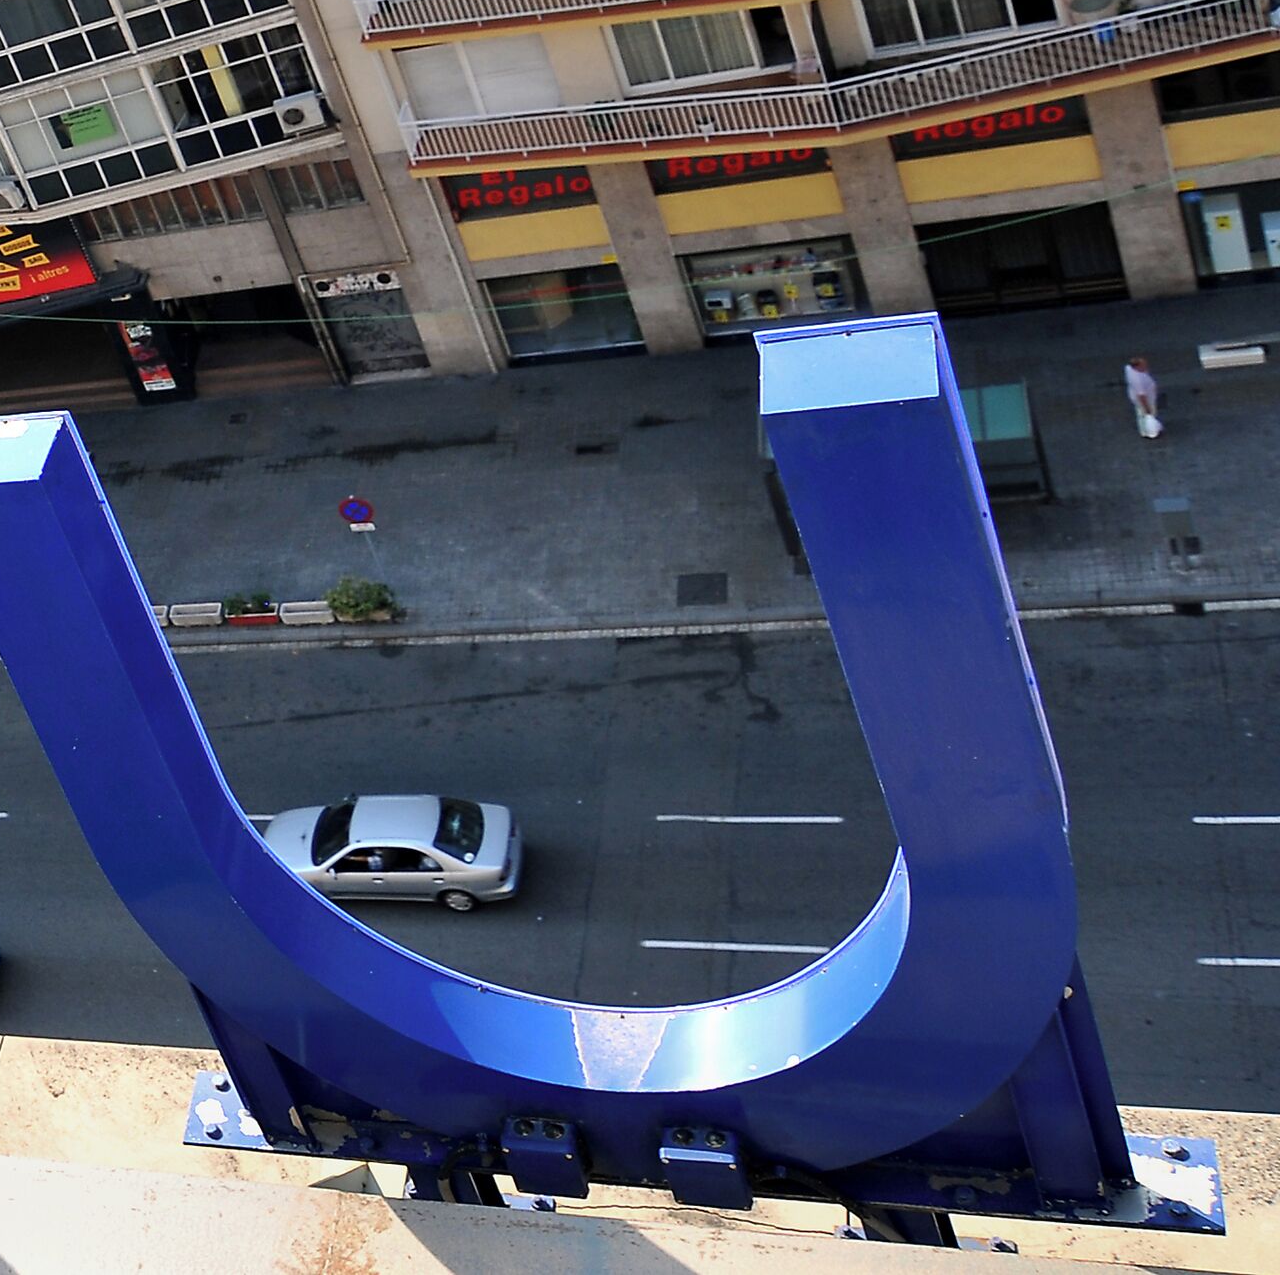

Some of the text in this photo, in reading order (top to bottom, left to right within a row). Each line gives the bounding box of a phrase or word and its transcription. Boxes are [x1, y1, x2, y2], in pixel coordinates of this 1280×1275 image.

[915, 103, 1066, 143] Regalo
[667, 146, 814, 180] Regalo
[458, 174, 591, 209] Regalo
[38, 265, 70, 282] altres
